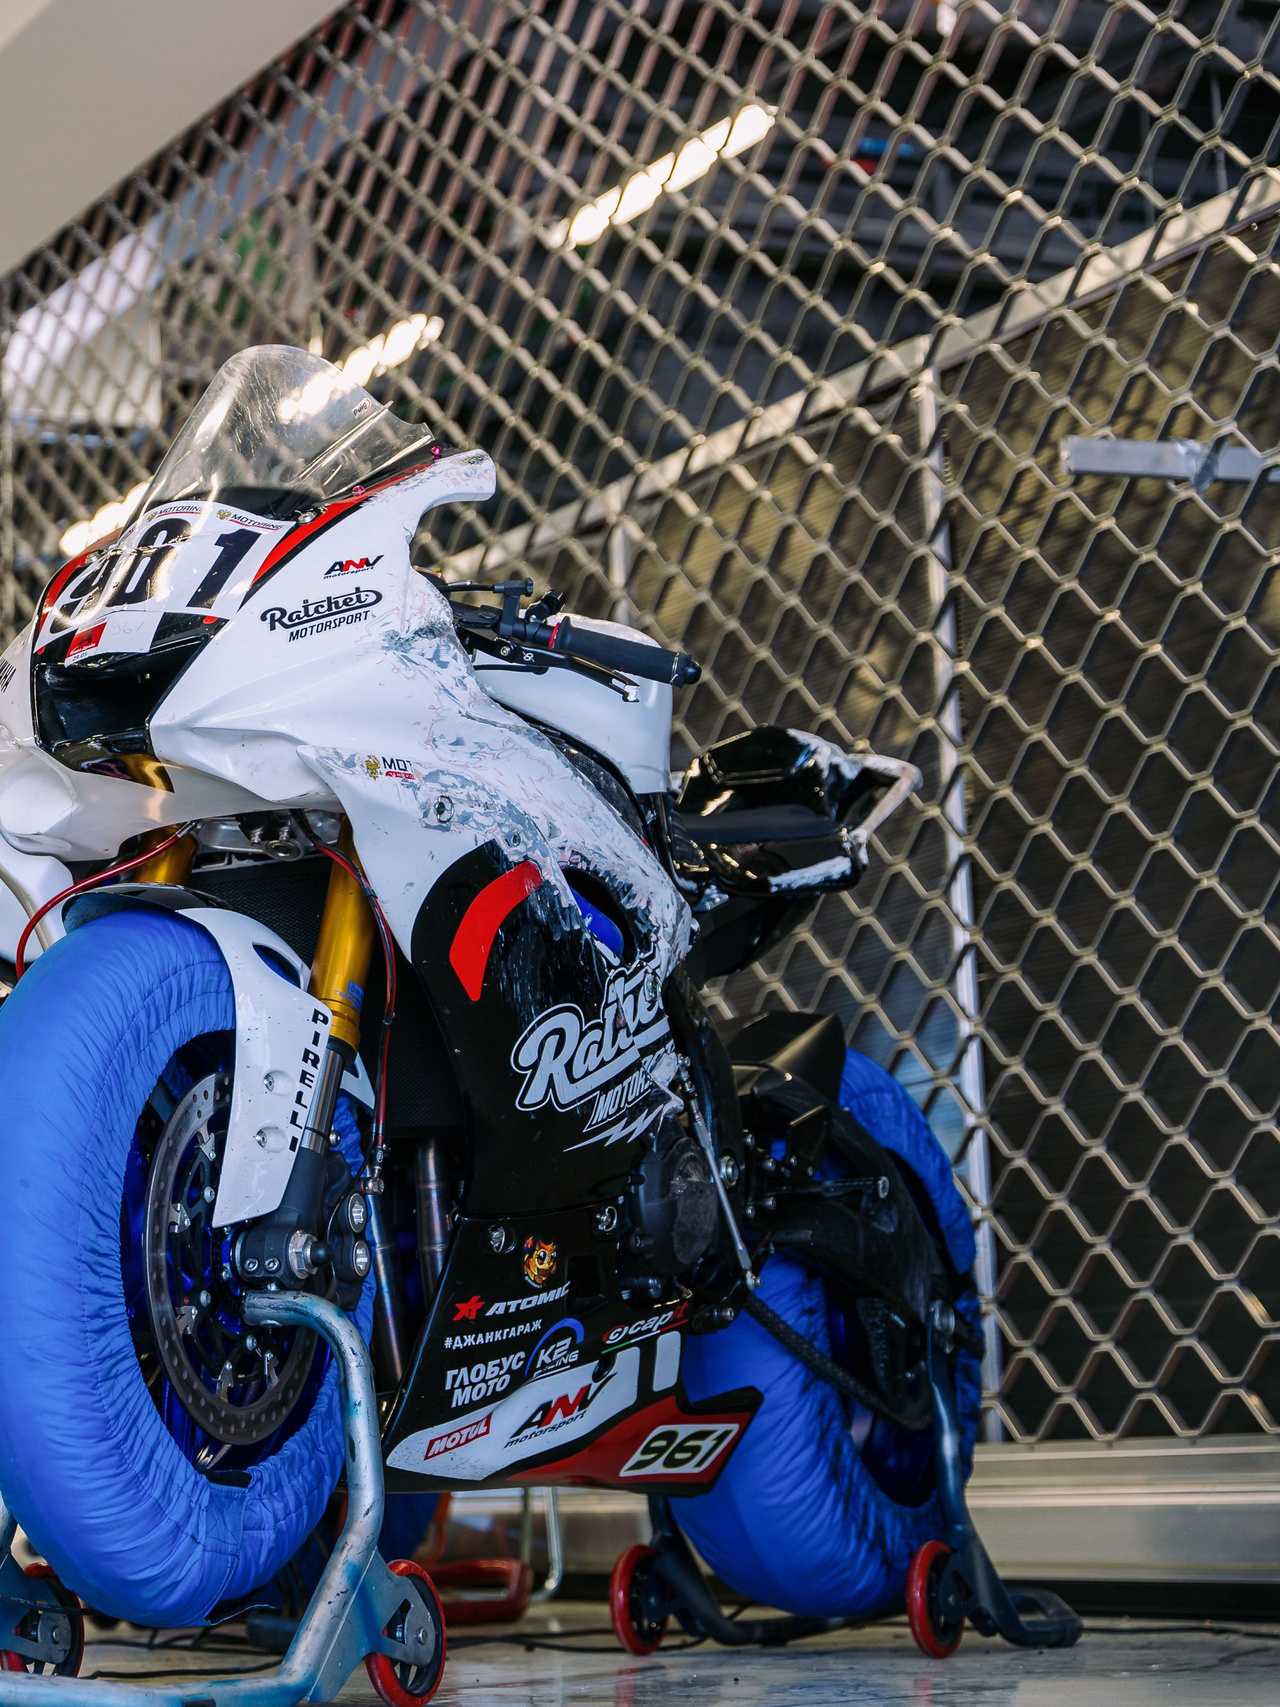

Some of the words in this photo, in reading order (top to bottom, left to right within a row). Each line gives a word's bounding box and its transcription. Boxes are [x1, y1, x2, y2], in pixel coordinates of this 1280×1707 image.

[260, 587, 383, 631] Ratchet
[288, 610, 370, 642] MOTORSPORT
[289, 1008, 329, 1153] PIRELLI
[485, 1281, 571, 1316] ATOMIC
[444, 1319, 542, 1350] #ДЖАНКГАРАЖ
[445, 1351, 526, 1390] ГЛОБУС
[451, 1374, 511, 1408] МОТО
[426, 1415, 490, 1458] MOTUL
[503, 1410, 587, 1449] motorsport
[623, 1429, 735, 1473] 961
